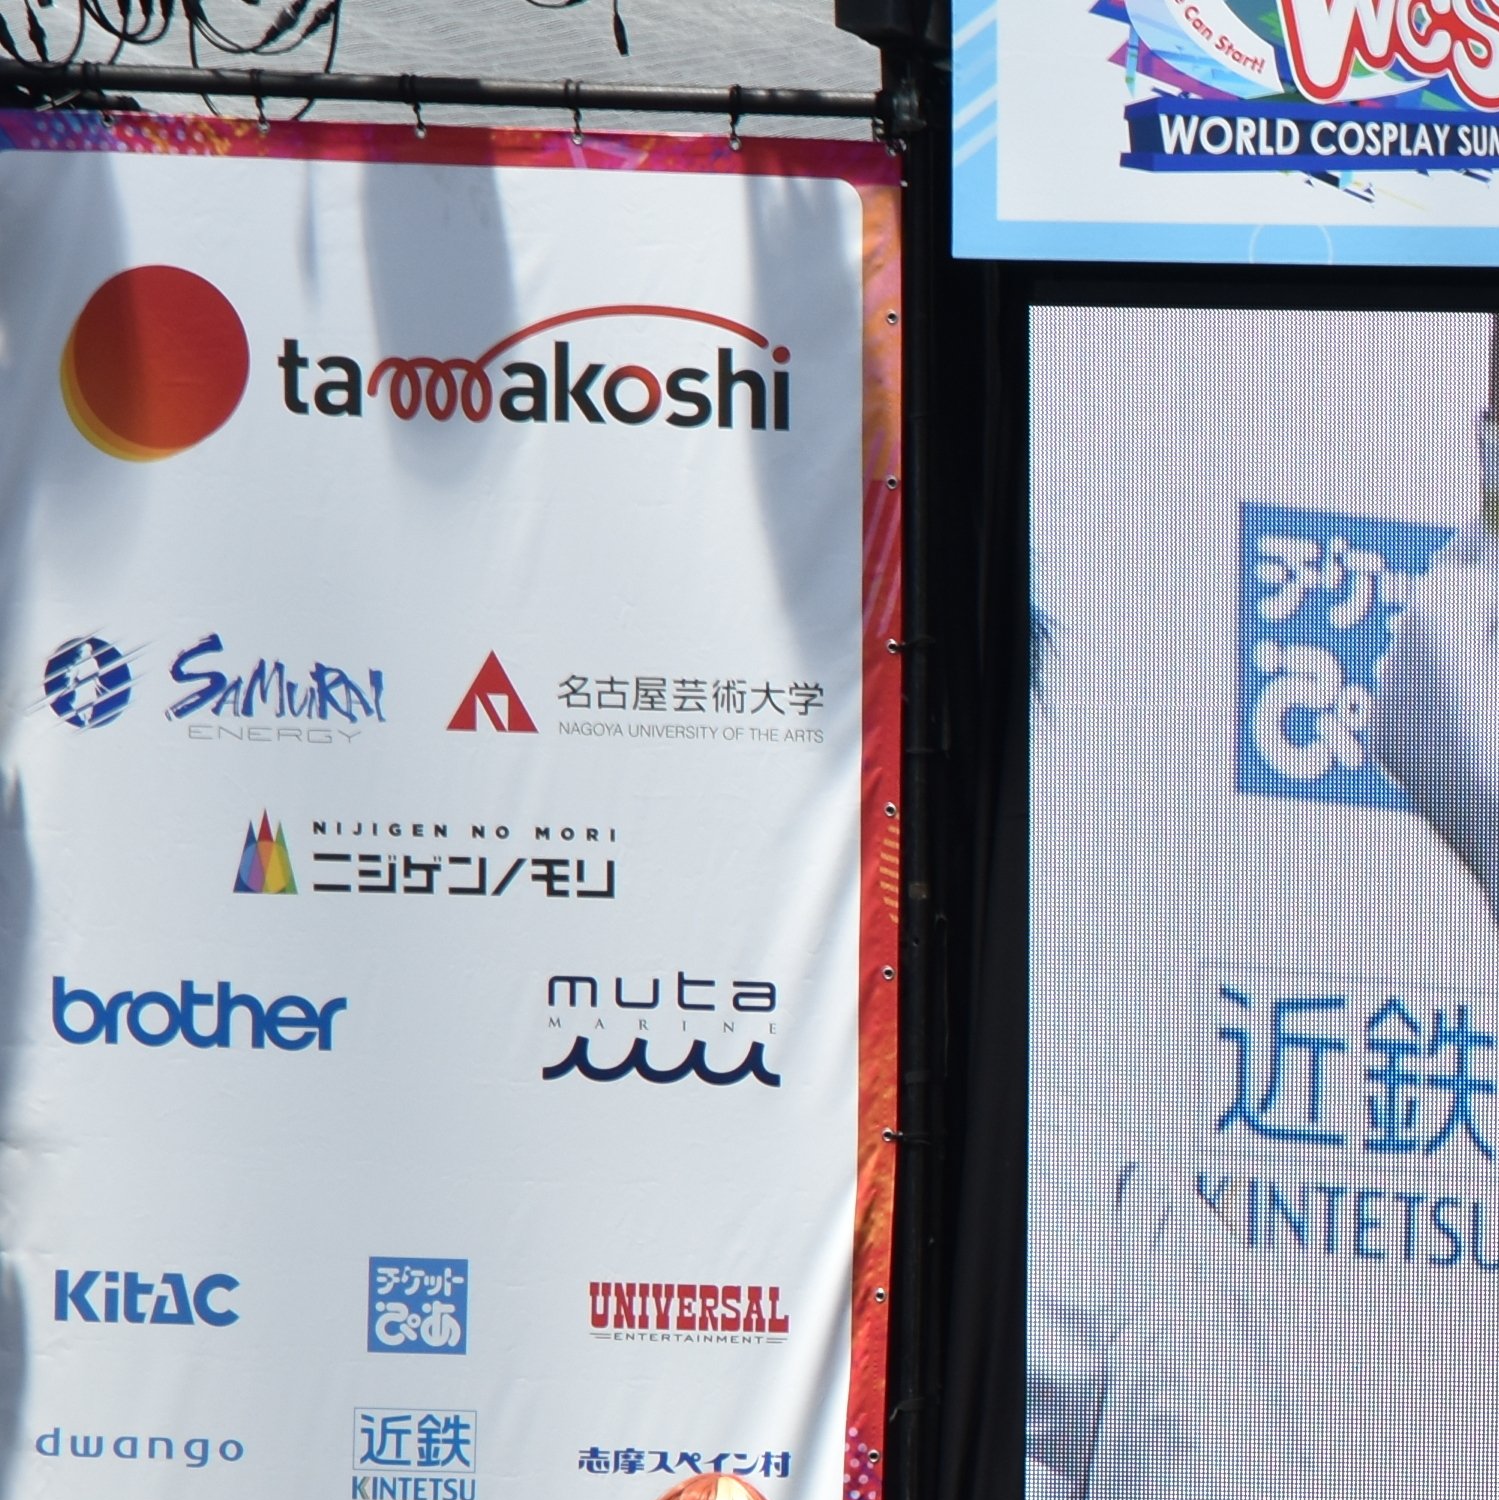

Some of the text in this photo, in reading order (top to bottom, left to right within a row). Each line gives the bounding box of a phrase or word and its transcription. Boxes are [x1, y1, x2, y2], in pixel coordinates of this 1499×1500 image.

[1184, 5, 1266, 74] Can Start!
[1159, 114, 1301, 157] WORLD
[1310, 117, 1452, 158] COSPLAY
[278, 304, 792, 432] tamakoshi
[557, 674, 825, 716] 名古屋芸術大学
[188, 725, 362, 745] ENERGY
[558, 721, 825, 744] NAGOYA UNIVERSITY OF THE ARTS
[313, 821, 616, 843] NIJIGEN NO MORI
[313, 853, 615, 899] ニジゲンノモリ
[547, 971, 777, 1013] muta
[52, 976, 348, 1052] brother
[547, 1016, 777, 1035] MARINE
[1216, 984, 1498, 1161] 近鉄
[376, 1267, 465, 1297] チケット
[375, 1300, 462, 1348] ぴあ
[589, 1282, 790, 1334] UNIVERSAL
[613, 1333, 765, 1345] ENTERTAINMENT
[35, 1427, 244, 1469] dwango
[360, 1413, 471, 1469] 近鉄
[578, 1447, 792, 1478] 志摩スペイン村
